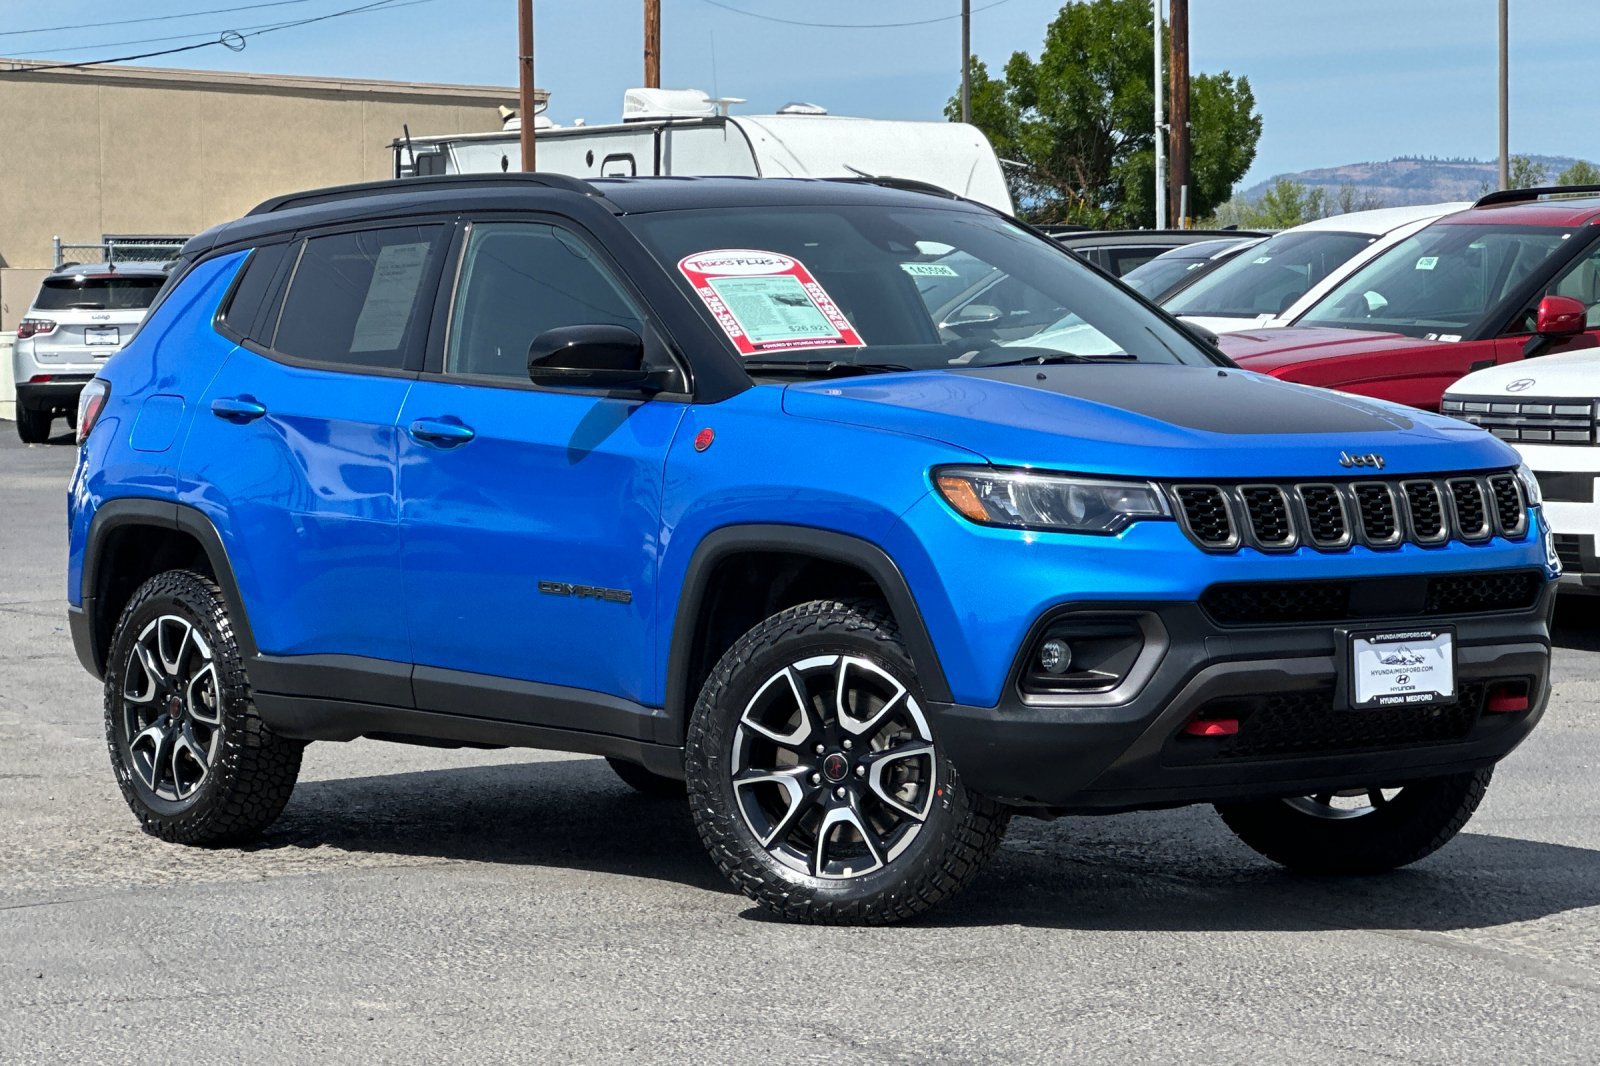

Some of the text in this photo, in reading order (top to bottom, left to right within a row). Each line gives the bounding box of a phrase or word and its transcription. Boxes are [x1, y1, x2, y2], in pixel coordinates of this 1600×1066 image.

[1339, 451, 1384, 469] Jeep
[538, 580, 632, 603] COMPASS
[1376, 631, 1431, 640] HYUNDAIMEDFORD.COM
[1371, 666, 1433, 675] HYUNDAIMEDFORD.COM
[1380, 694, 1432, 704] HYUNDAI MEDFORD
